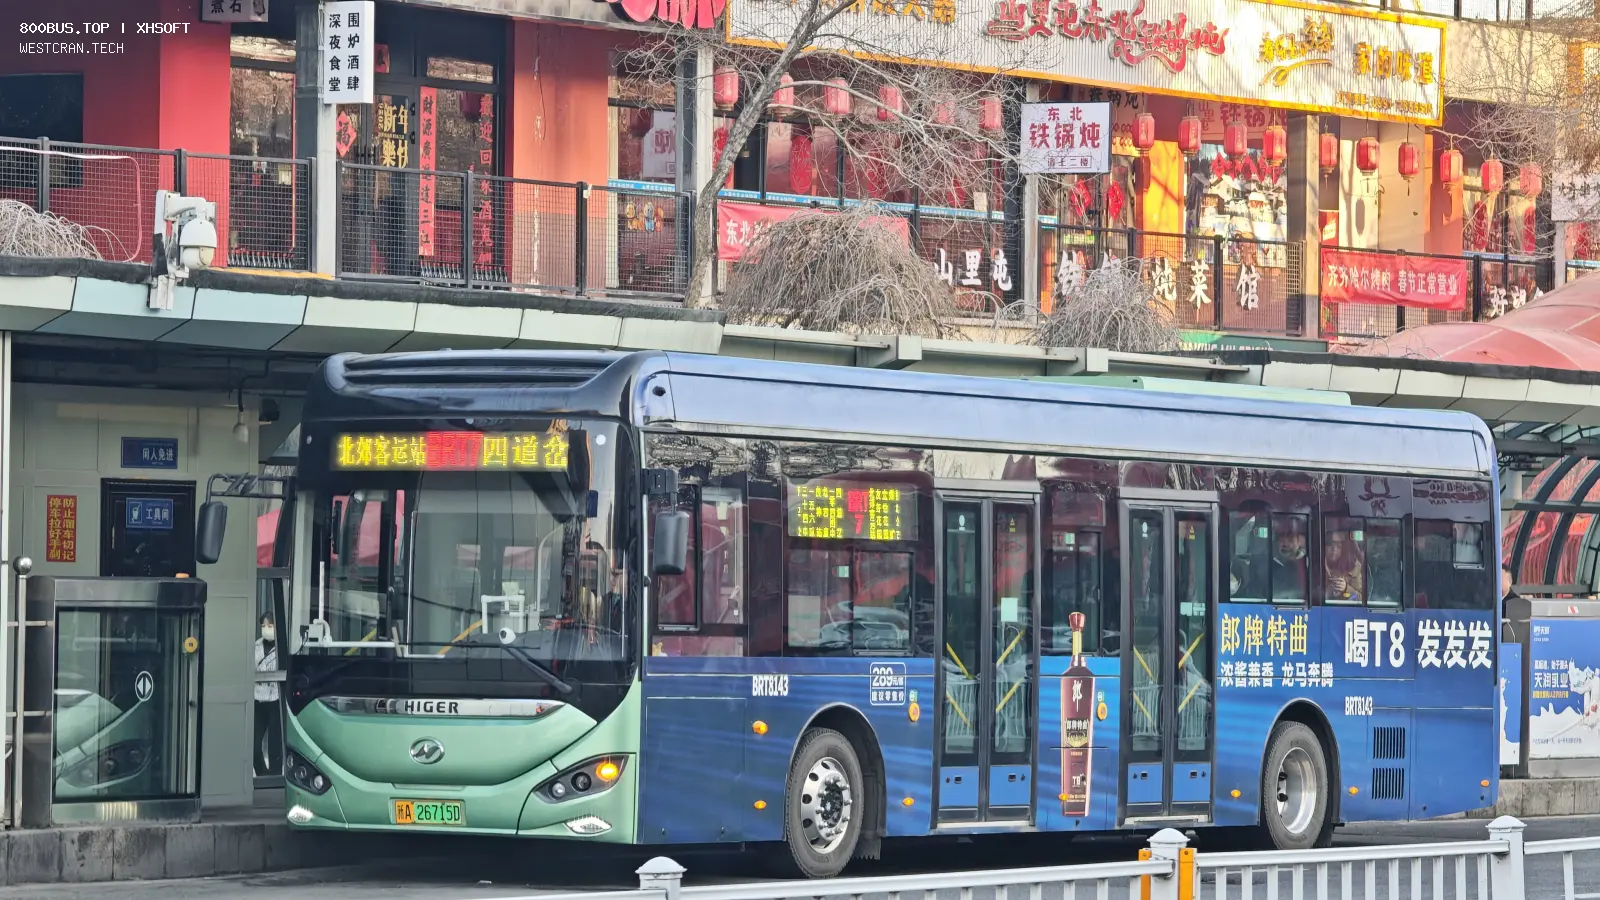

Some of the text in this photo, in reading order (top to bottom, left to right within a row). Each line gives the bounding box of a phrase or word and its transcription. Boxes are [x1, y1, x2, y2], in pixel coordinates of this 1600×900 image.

[328, 13, 341, 92] 深夜食堂
[347, 12, 360, 91] 围炉酒肆
[1047, 107, 1082, 120] 东北
[1029, 121, 1101, 149] 铁锅炖
[1327, 263, 1391, 292] 齐齐哈尔烤肉
[483, 434, 570, 468] 四道岔
[1220, 612, 1309, 657] 郎牌特曲
[1417, 618, 1492, 669] 发发发
[752, 674, 789, 697] BRT8143
[1220, 661, 1334, 688] 浓酱兼香 龙马奔腾
[404, 700, 459, 714] HIGER
[1344, 695, 1373, 716] BRT8143
[416, 804, 461, 821] 26715D
